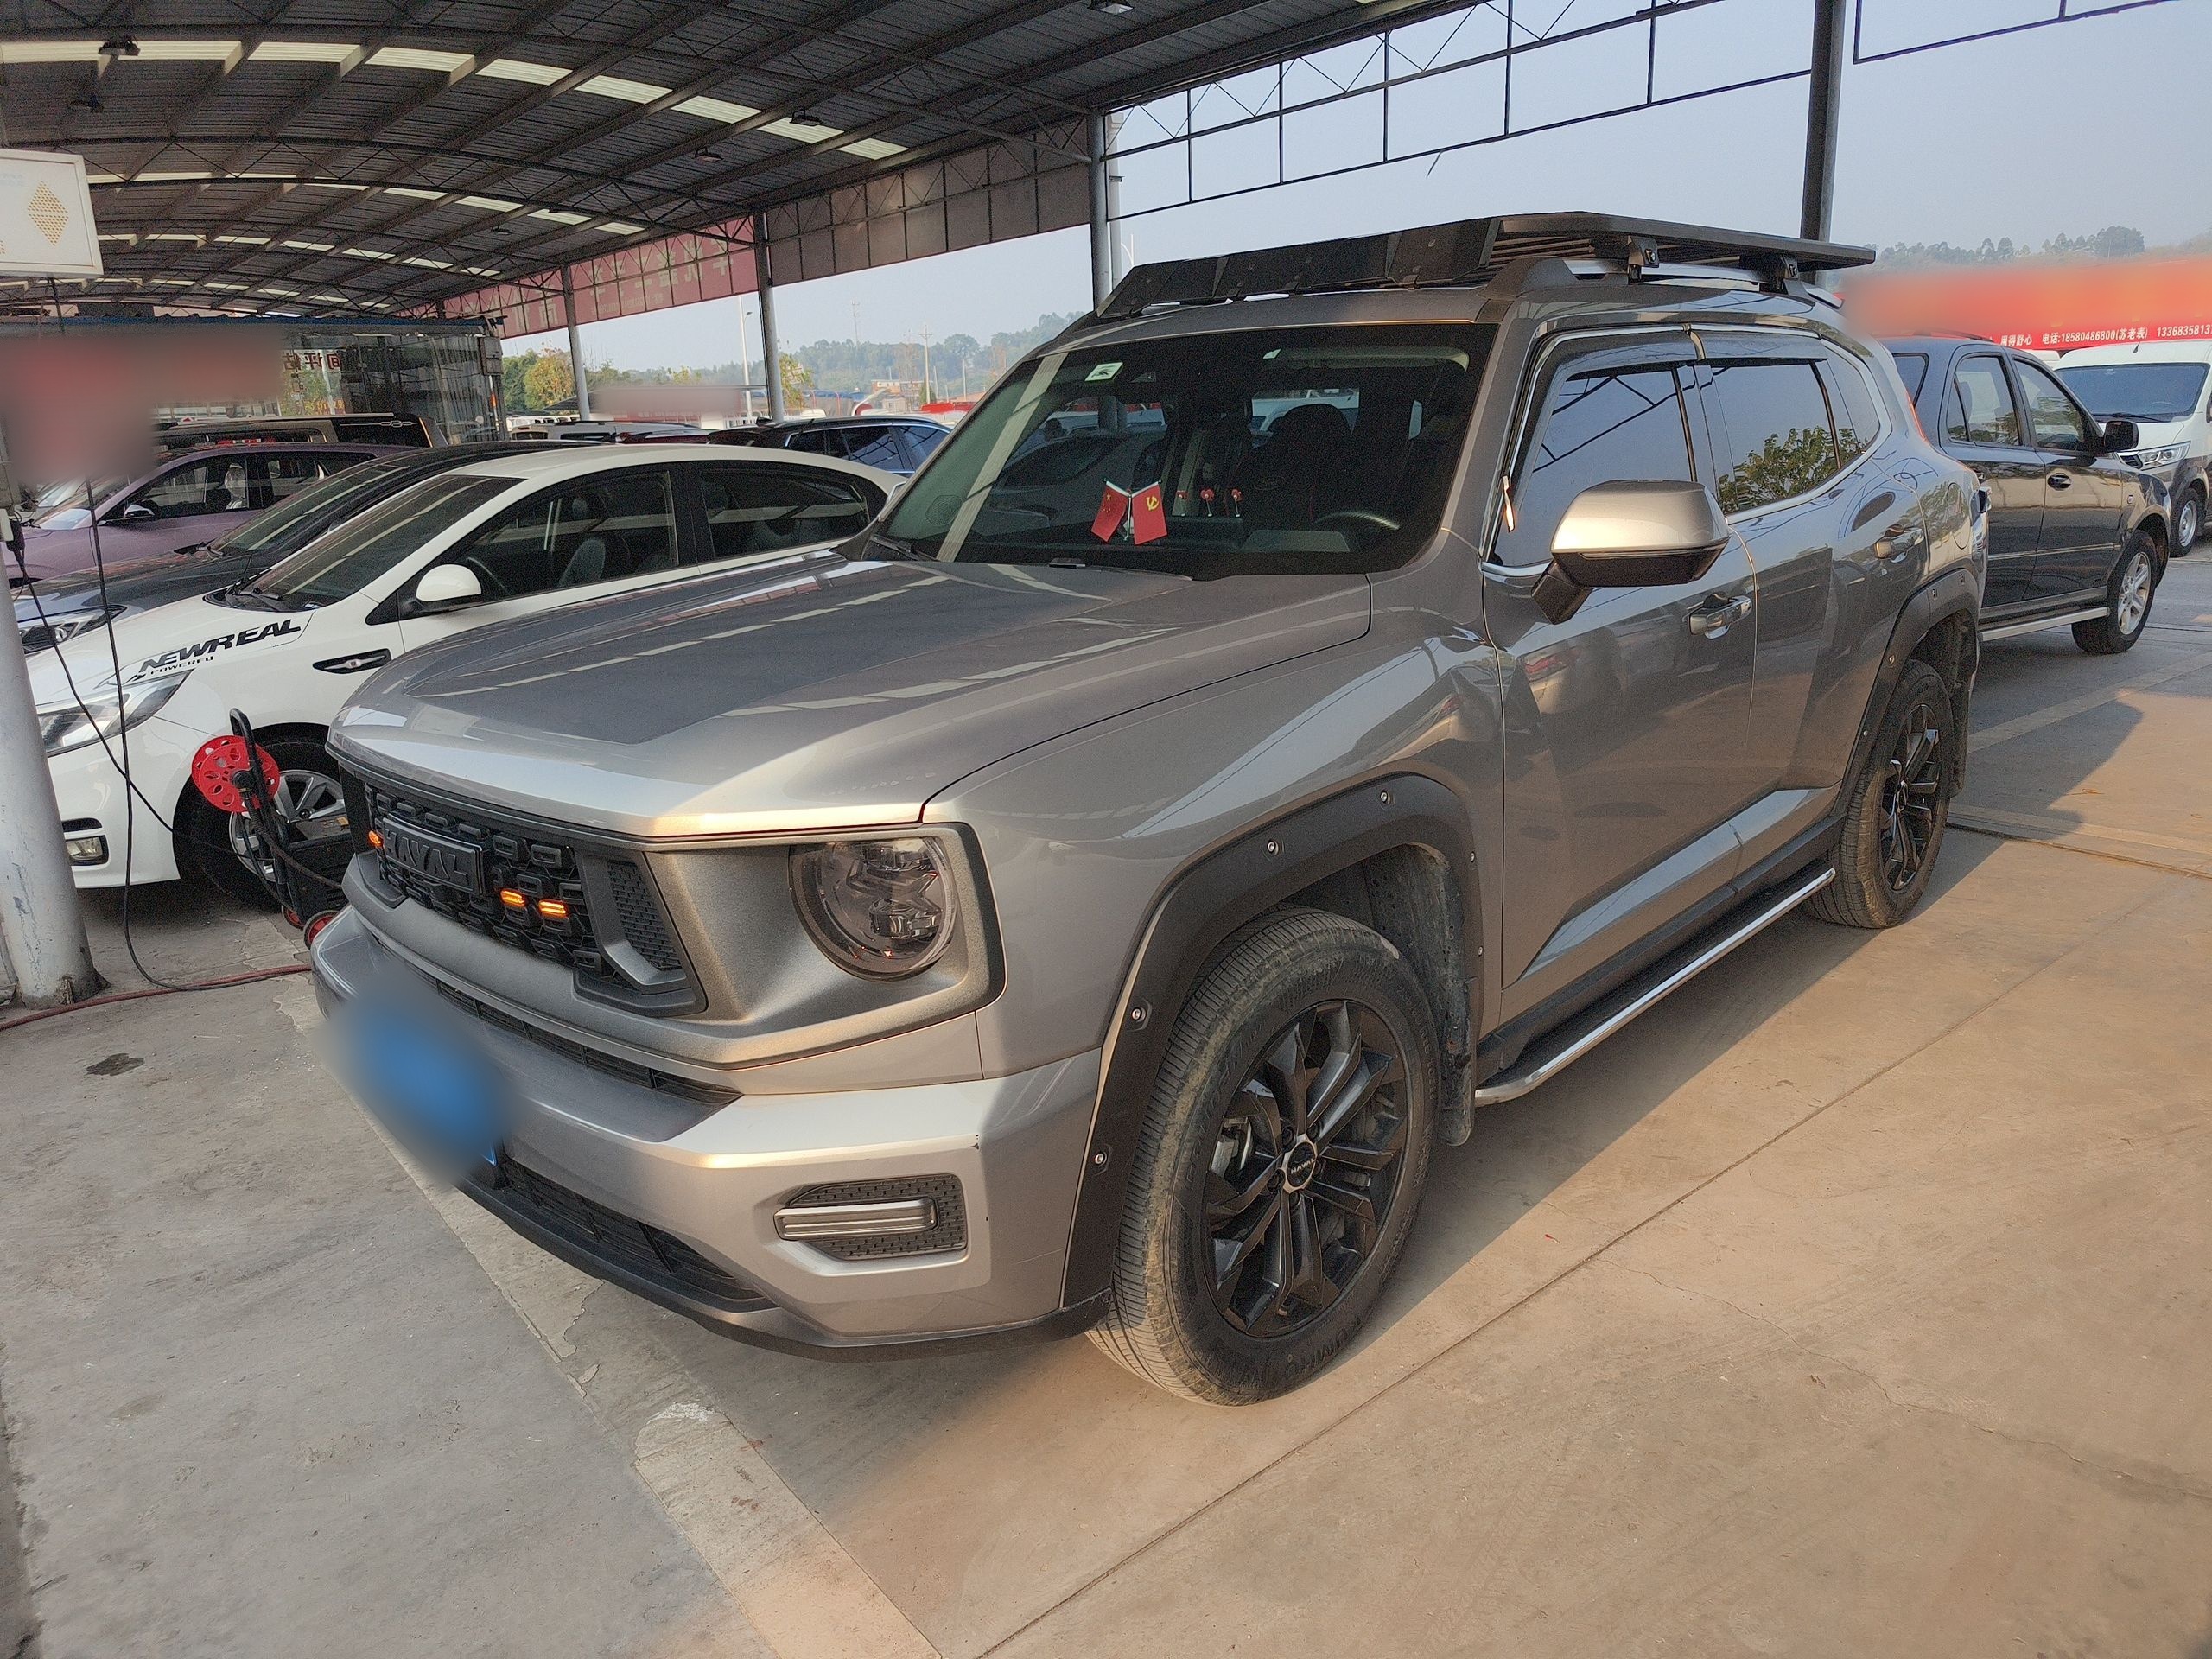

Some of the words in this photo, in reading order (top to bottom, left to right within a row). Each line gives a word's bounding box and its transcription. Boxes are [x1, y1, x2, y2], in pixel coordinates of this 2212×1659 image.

[2000, 334, 2033, 346] 用得舒心
[2157, 323, 2212, 338] 1336835813
[138, 619, 302, 673] NEWREAL
[383, 827, 469, 885] HAVAL
[1290, 1158, 1316, 1174] HAVAL
